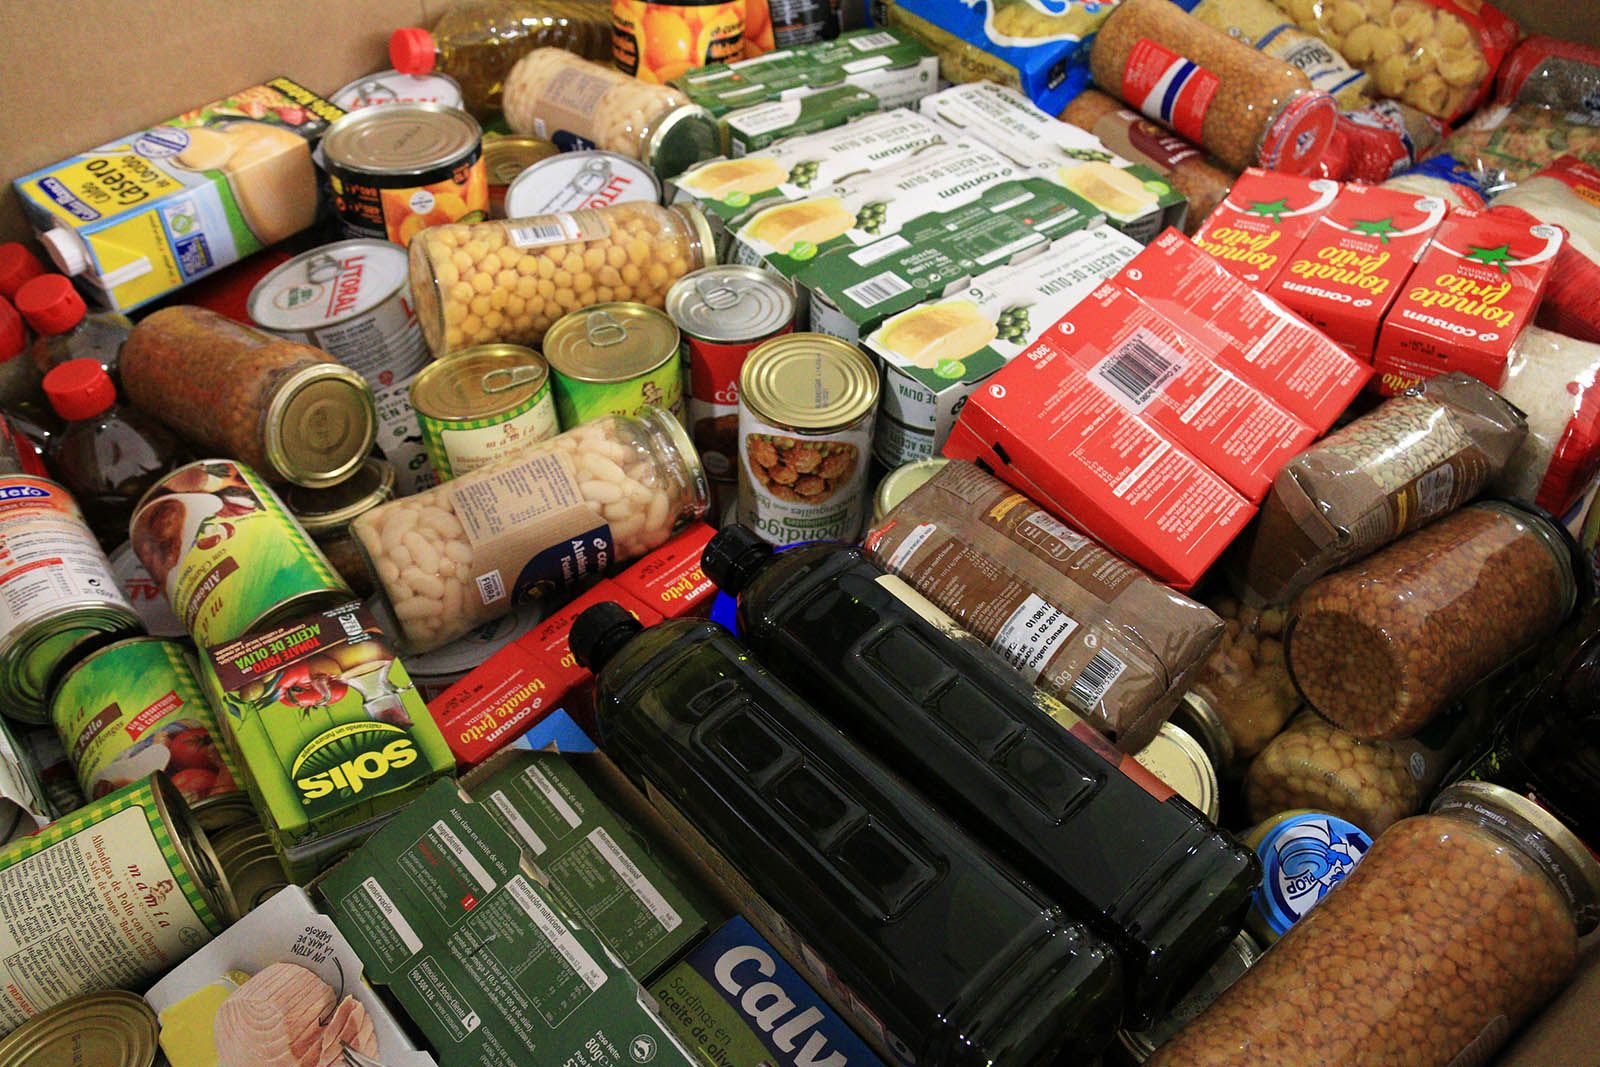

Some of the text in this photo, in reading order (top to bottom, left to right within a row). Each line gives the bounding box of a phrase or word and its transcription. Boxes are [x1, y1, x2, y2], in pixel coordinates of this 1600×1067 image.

[867, 137, 928, 162] consum
[85, 158, 151, 207] Casero
[602, 174, 633, 208] LITO
[935, 169, 999, 202] consum
[1210, 219, 1280, 255] frito
[1315, 239, 1390, 276] frito
[326, 254, 366, 319] LITORAL
[1037, 251, 1119, 299] ACEITE DE OLIVA
[1281, 280, 1351, 303] consum
[1289, 258, 1390, 296] tomate
[1432, 269, 1512, 307] frito
[968, 286, 983, 301] 6
[1406, 284, 1515, 329] tomate
[1401, 309, 1477, 337] consum
[1026, 341, 1049, 362] 390g
[900, 385, 923, 403] OLIVA
[480, 576, 497, 600] FIBRA
[658, 575, 694, 606] frito
[1024, 600, 1052, 629] 01/08/17
[233, 623, 321, 670] ACEITE DE OLIVA
[1027, 621, 1068, 669] Origen Canada
[1030, 632, 1041, 643] 01
[1038, 623, 1048, 633] 02
[252, 635, 320, 673] TOMATE FRITO
[494, 676, 546, 720] tomate
[77, 716, 103, 746] Pollo
[458, 713, 497, 747] frito
[484, 704, 532, 743] consum
[296, 738, 418, 800] solis
[435, 822, 465, 855] Ingredientes
[449, 806, 463, 821] Atún
[470, 831, 479, 840] en
[475, 838, 492, 856] aceite
[488, 852, 498, 863] de
[494, 860, 509, 876] oliva.
[86, 885, 101, 903] Agua
[88, 859, 123, 918] Salsa de hongos
[90, 832, 146, 933] Albóndigas de Pollo con
[364, 880, 393, 915] Conservación
[1283, 871, 1317, 896] PLOP
[41, 902, 62, 929] gluten),
[73, 894, 89, 915] rallado
[513, 877, 543, 910] Información
[538, 905, 566, 936] nutricional
[295, 932, 334, 956] LA MAR DE
[303, 923, 332, 944] SABROSO
[311, 950, 326, 964] UN
[490, 963, 503, 976] base
[409, 970, 421, 982] 900
[424, 989, 435, 1000] 126
[419, 960, 440, 983] Atención
[439, 985, 467, 1019] Socio-Cliente
[451, 931, 468, 950] Fuente
[468, 953, 486, 973] omega
[498, 988, 506, 997] en
[503, 995, 515, 1007] 100
[514, 1008, 524, 1018] de
[656, 986, 695, 1029] aceite
[689, 1023, 711, 1045] de
[668, 975, 733, 1047] Sardinas en
[594, 1029, 609, 1045] Peso
